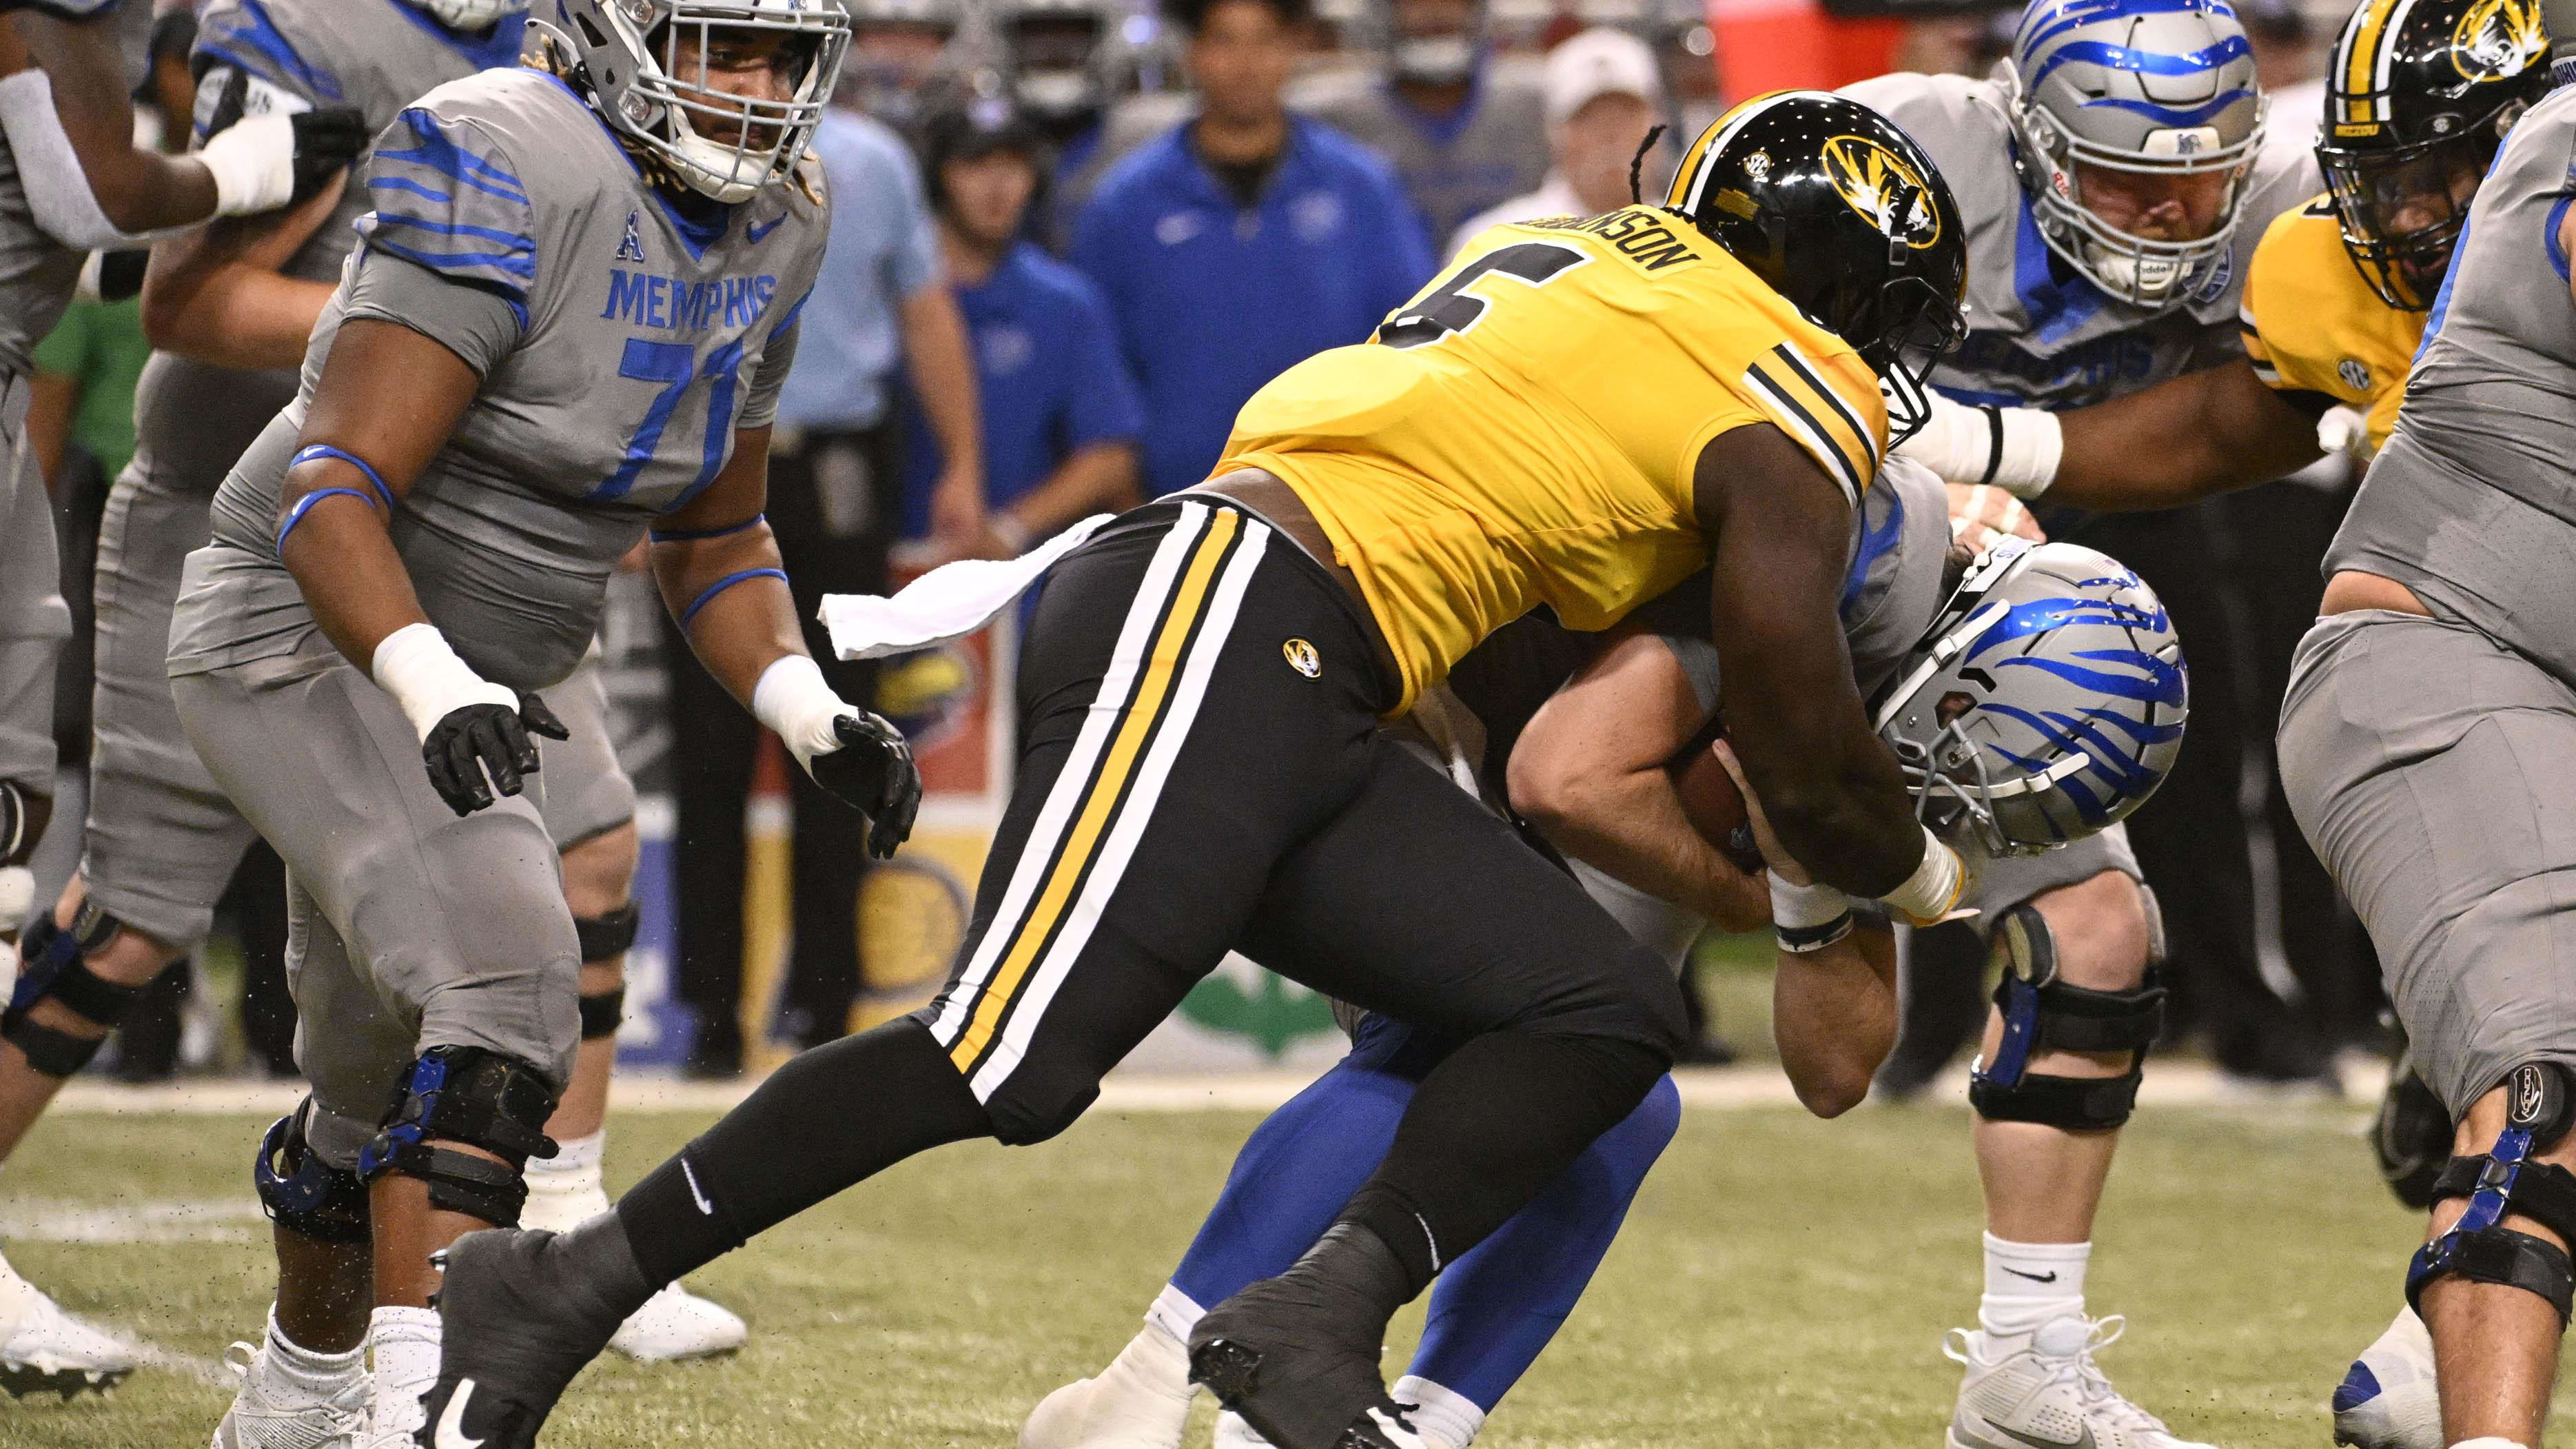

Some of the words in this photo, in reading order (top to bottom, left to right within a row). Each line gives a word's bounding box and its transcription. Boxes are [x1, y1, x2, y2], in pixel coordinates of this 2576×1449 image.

[1746, 153, 1769, 175] SEC
[600, 268, 777, 330] MEMPHIS
[580, 336, 744, 511] 71
[2521, 1068, 2531, 1118] DONJOY
